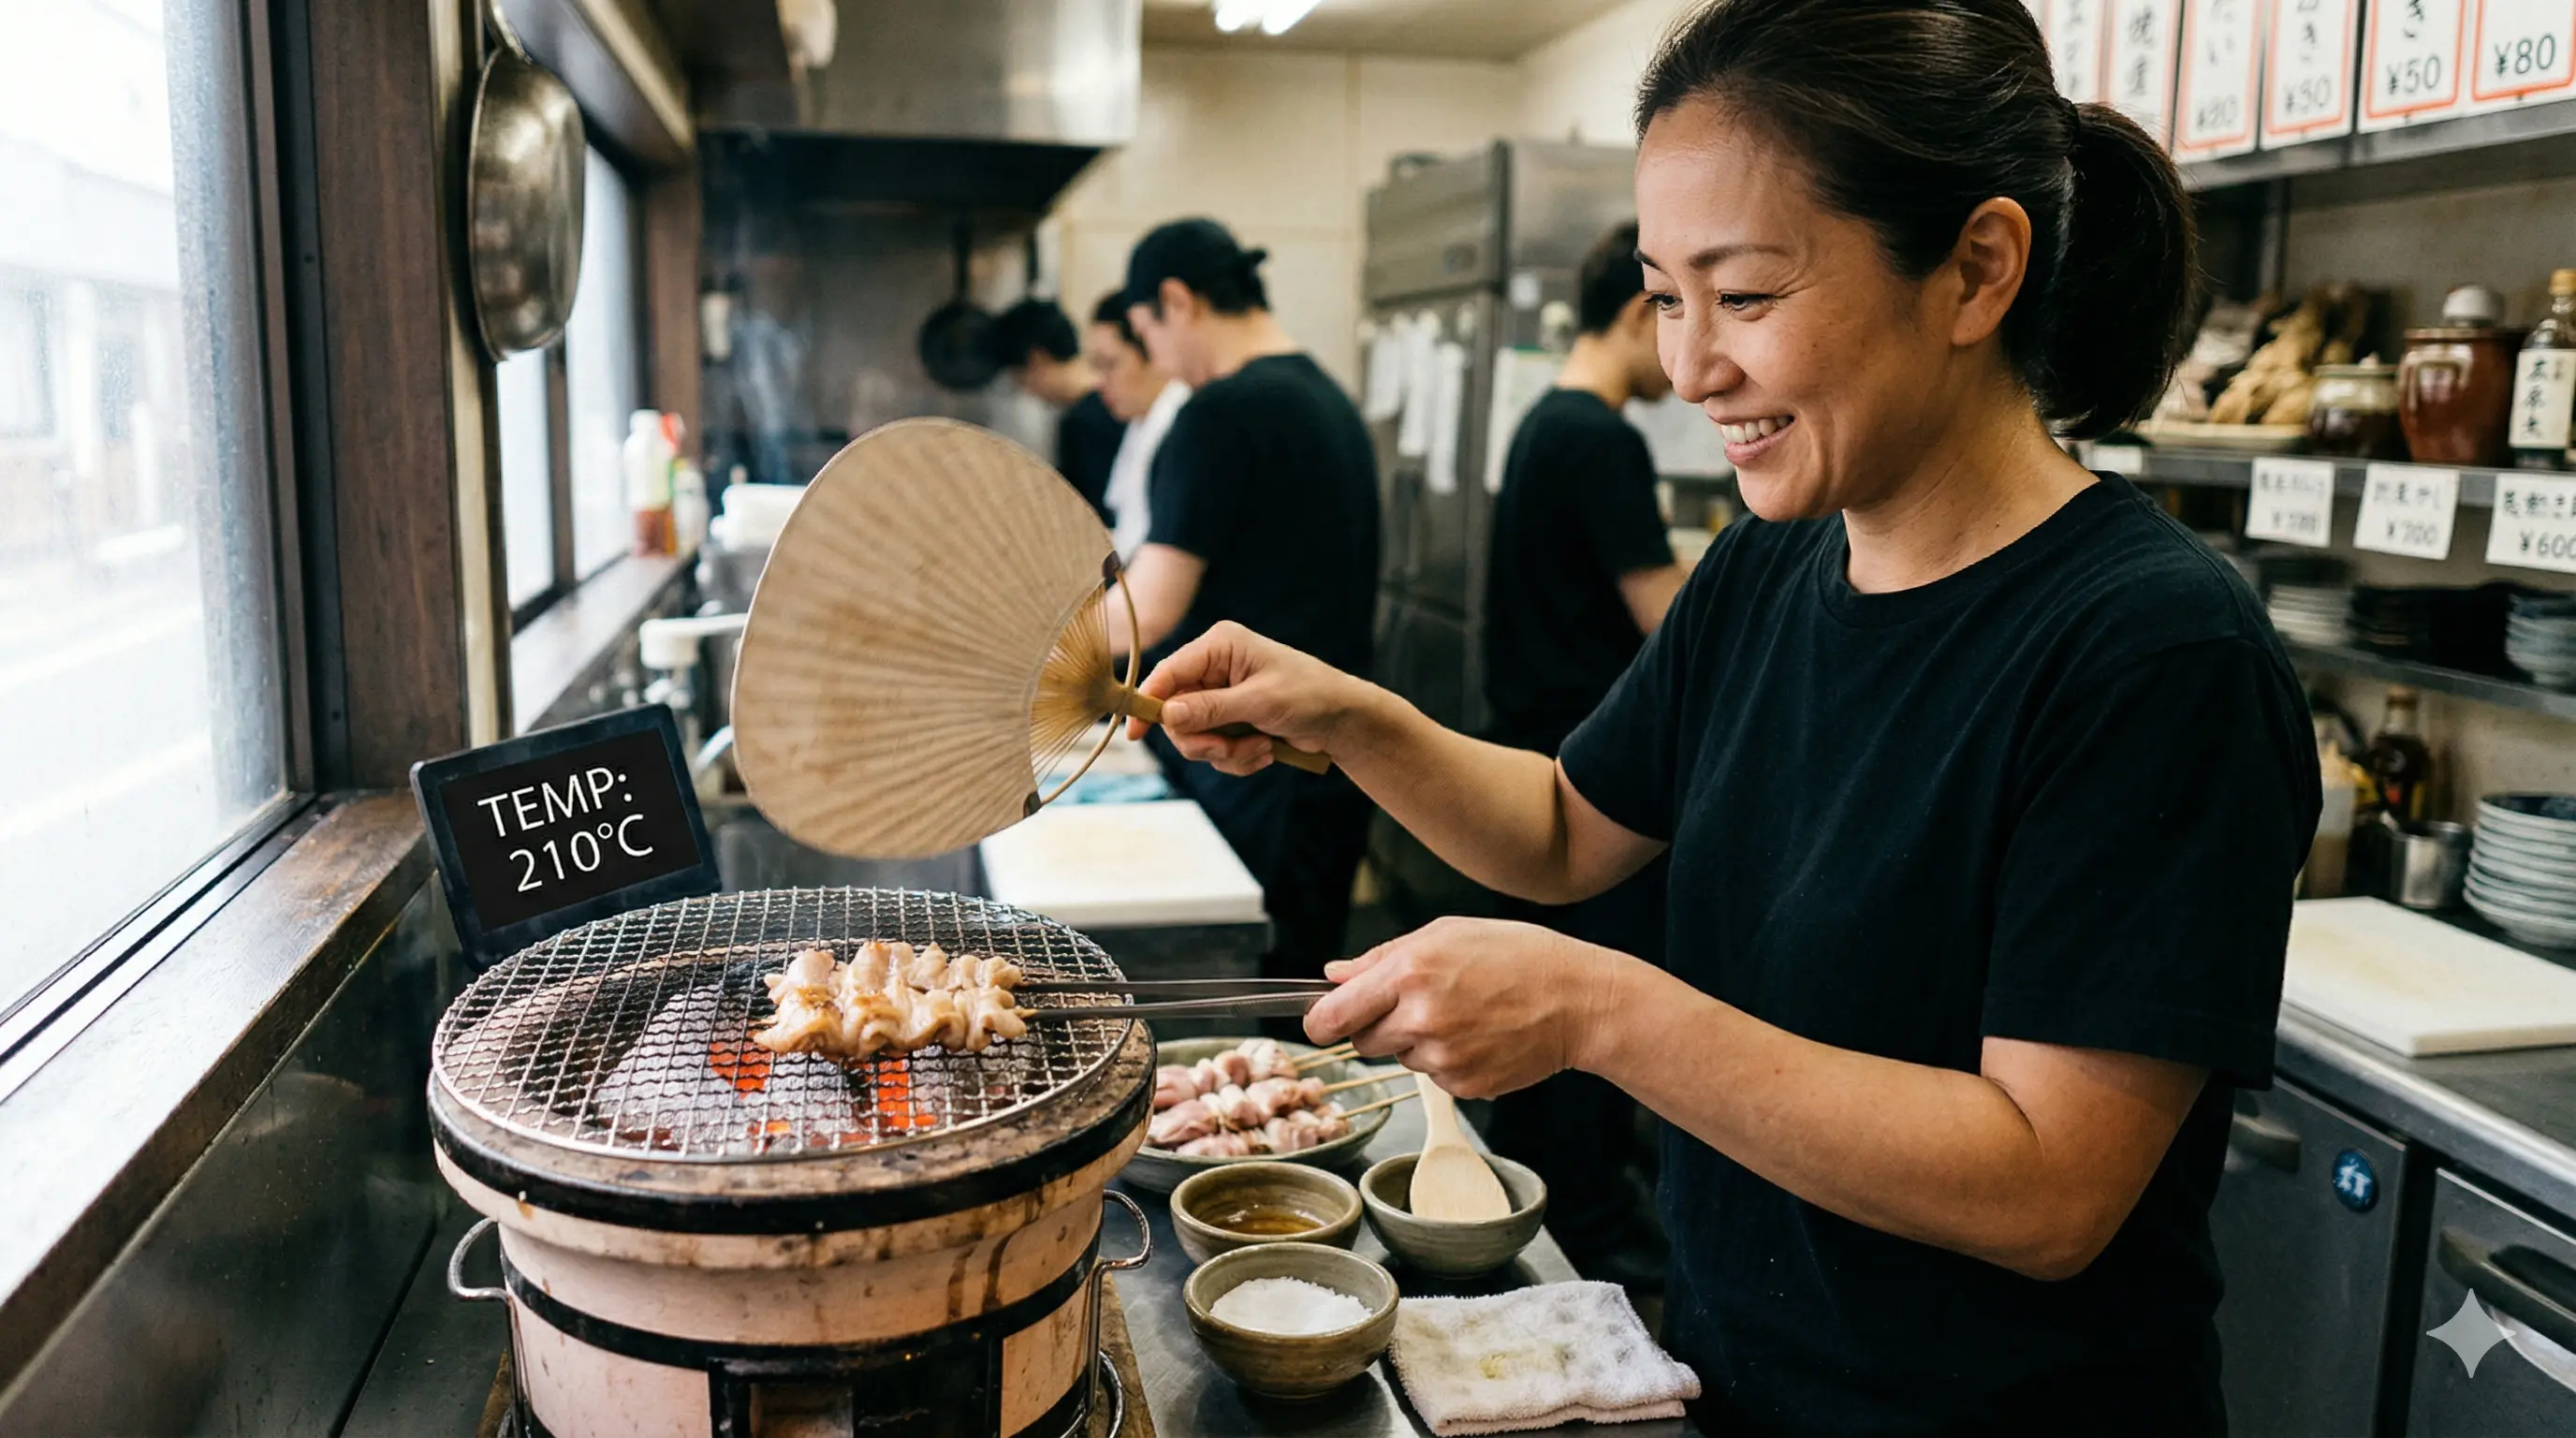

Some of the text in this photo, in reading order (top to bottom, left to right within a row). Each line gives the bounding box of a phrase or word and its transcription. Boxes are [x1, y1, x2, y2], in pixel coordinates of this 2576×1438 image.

[2386, 53, 2442, 95] ¥50
[2494, 32, 2556, 79] ¥80
[477, 767, 633, 838] TEMP:
[508, 814, 653, 892] 210°C
